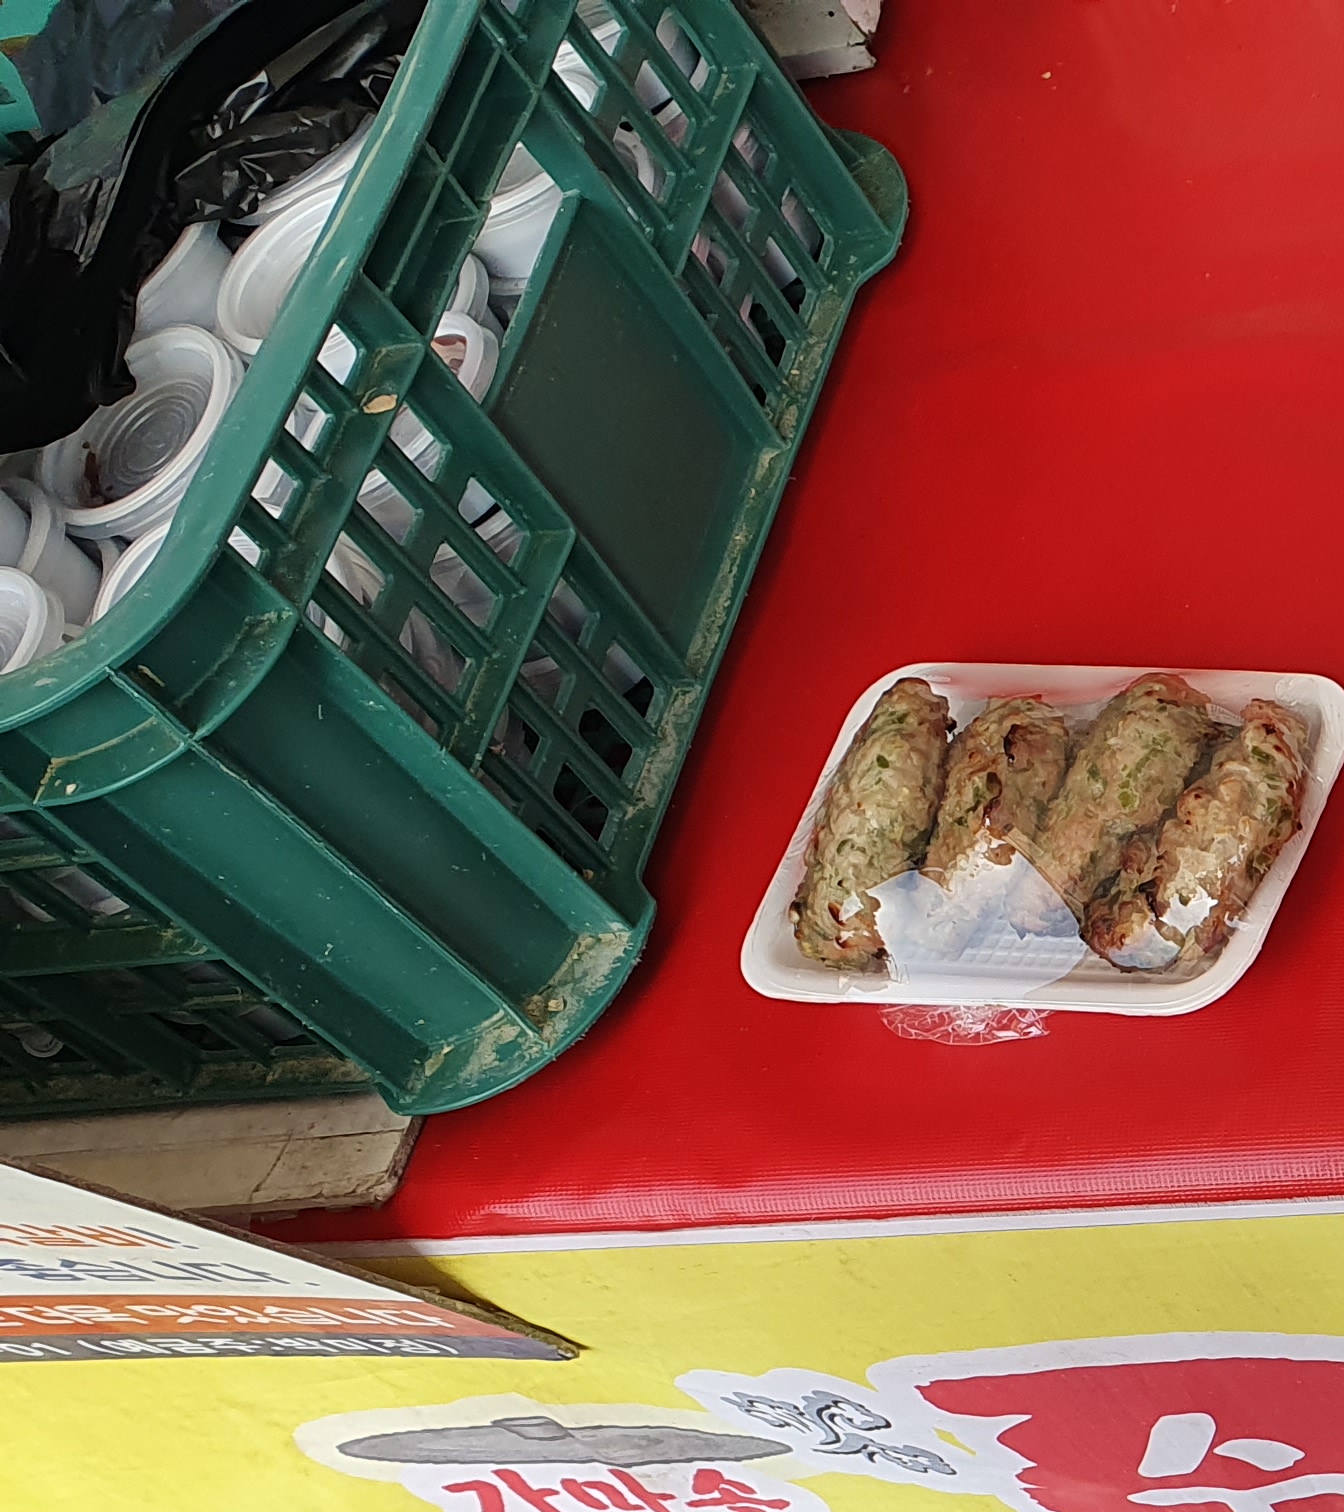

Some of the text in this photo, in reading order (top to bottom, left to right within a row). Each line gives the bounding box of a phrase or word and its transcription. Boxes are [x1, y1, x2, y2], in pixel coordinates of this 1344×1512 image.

[0, 1223, 200, 1250] 갈비!
[124, 1304, 455, 1329] 맛있습니다
[77, 1337, 459, 1356] (예금주:박미정)
